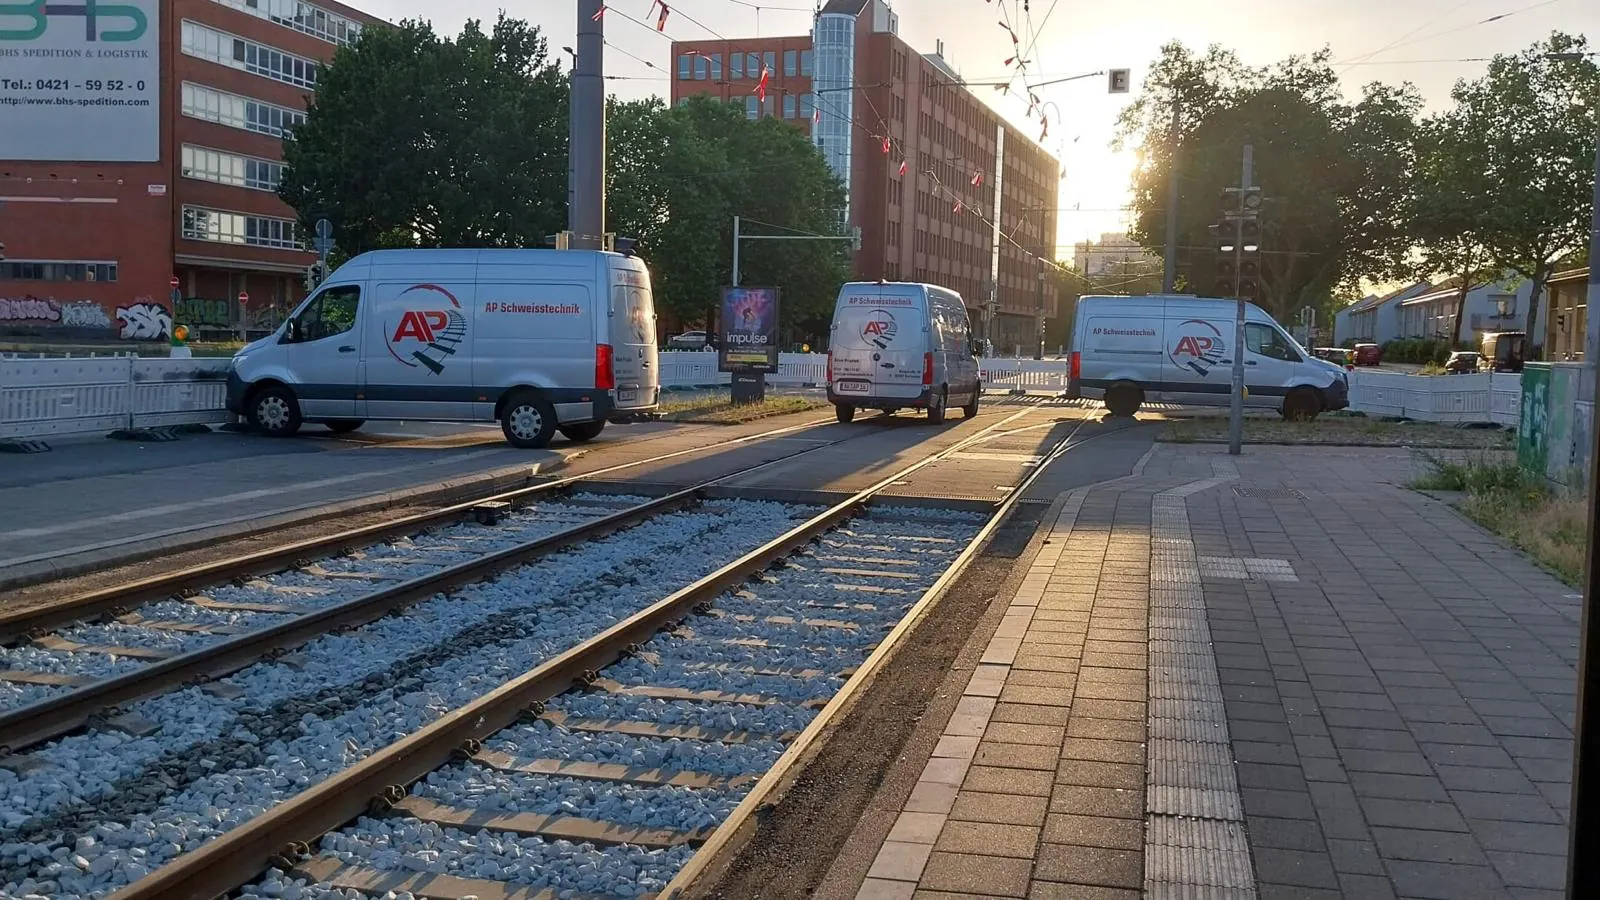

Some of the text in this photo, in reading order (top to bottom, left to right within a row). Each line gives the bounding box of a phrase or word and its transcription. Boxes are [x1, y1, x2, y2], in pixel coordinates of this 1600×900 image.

[23, 49, 82, 58] SPEDITION
[85, 50, 94, 58] &
[97, 50, 148, 59] LOGISTIK
[2, 79, 32, 90] Tel.:
[36, 79, 69, 91] 0421
[85, 80, 102, 91] 59
[107, 80, 124, 91] 52
[136, 80, 145, 91] 0
[1112, 70, 1125, 90] E
[485, 302, 580, 315] AP Schweisstechnik
[392, 311, 448, 343] AP
[863, 321, 889, 335] AP
[1103, 328, 1156, 337] Schweisstechnik
[727, 332, 768, 344] impulse
[1173, 336, 1214, 357] AP
